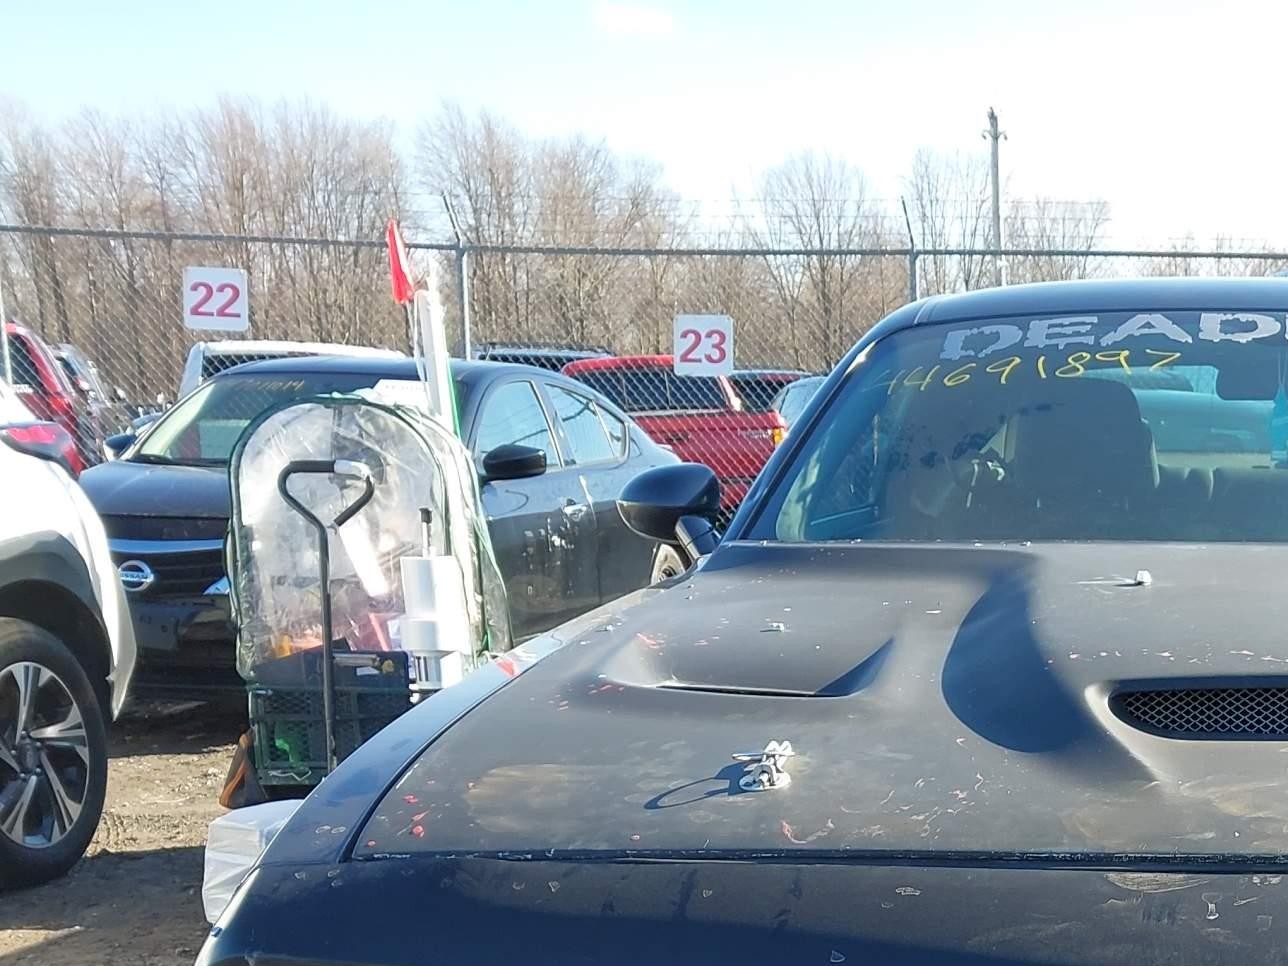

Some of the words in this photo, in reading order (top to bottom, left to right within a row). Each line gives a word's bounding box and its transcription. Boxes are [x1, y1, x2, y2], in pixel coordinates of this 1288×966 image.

[189, 281, 241, 319] 22
[679, 327, 728, 364] 23
[866, 349, 1181, 395] 44691897
